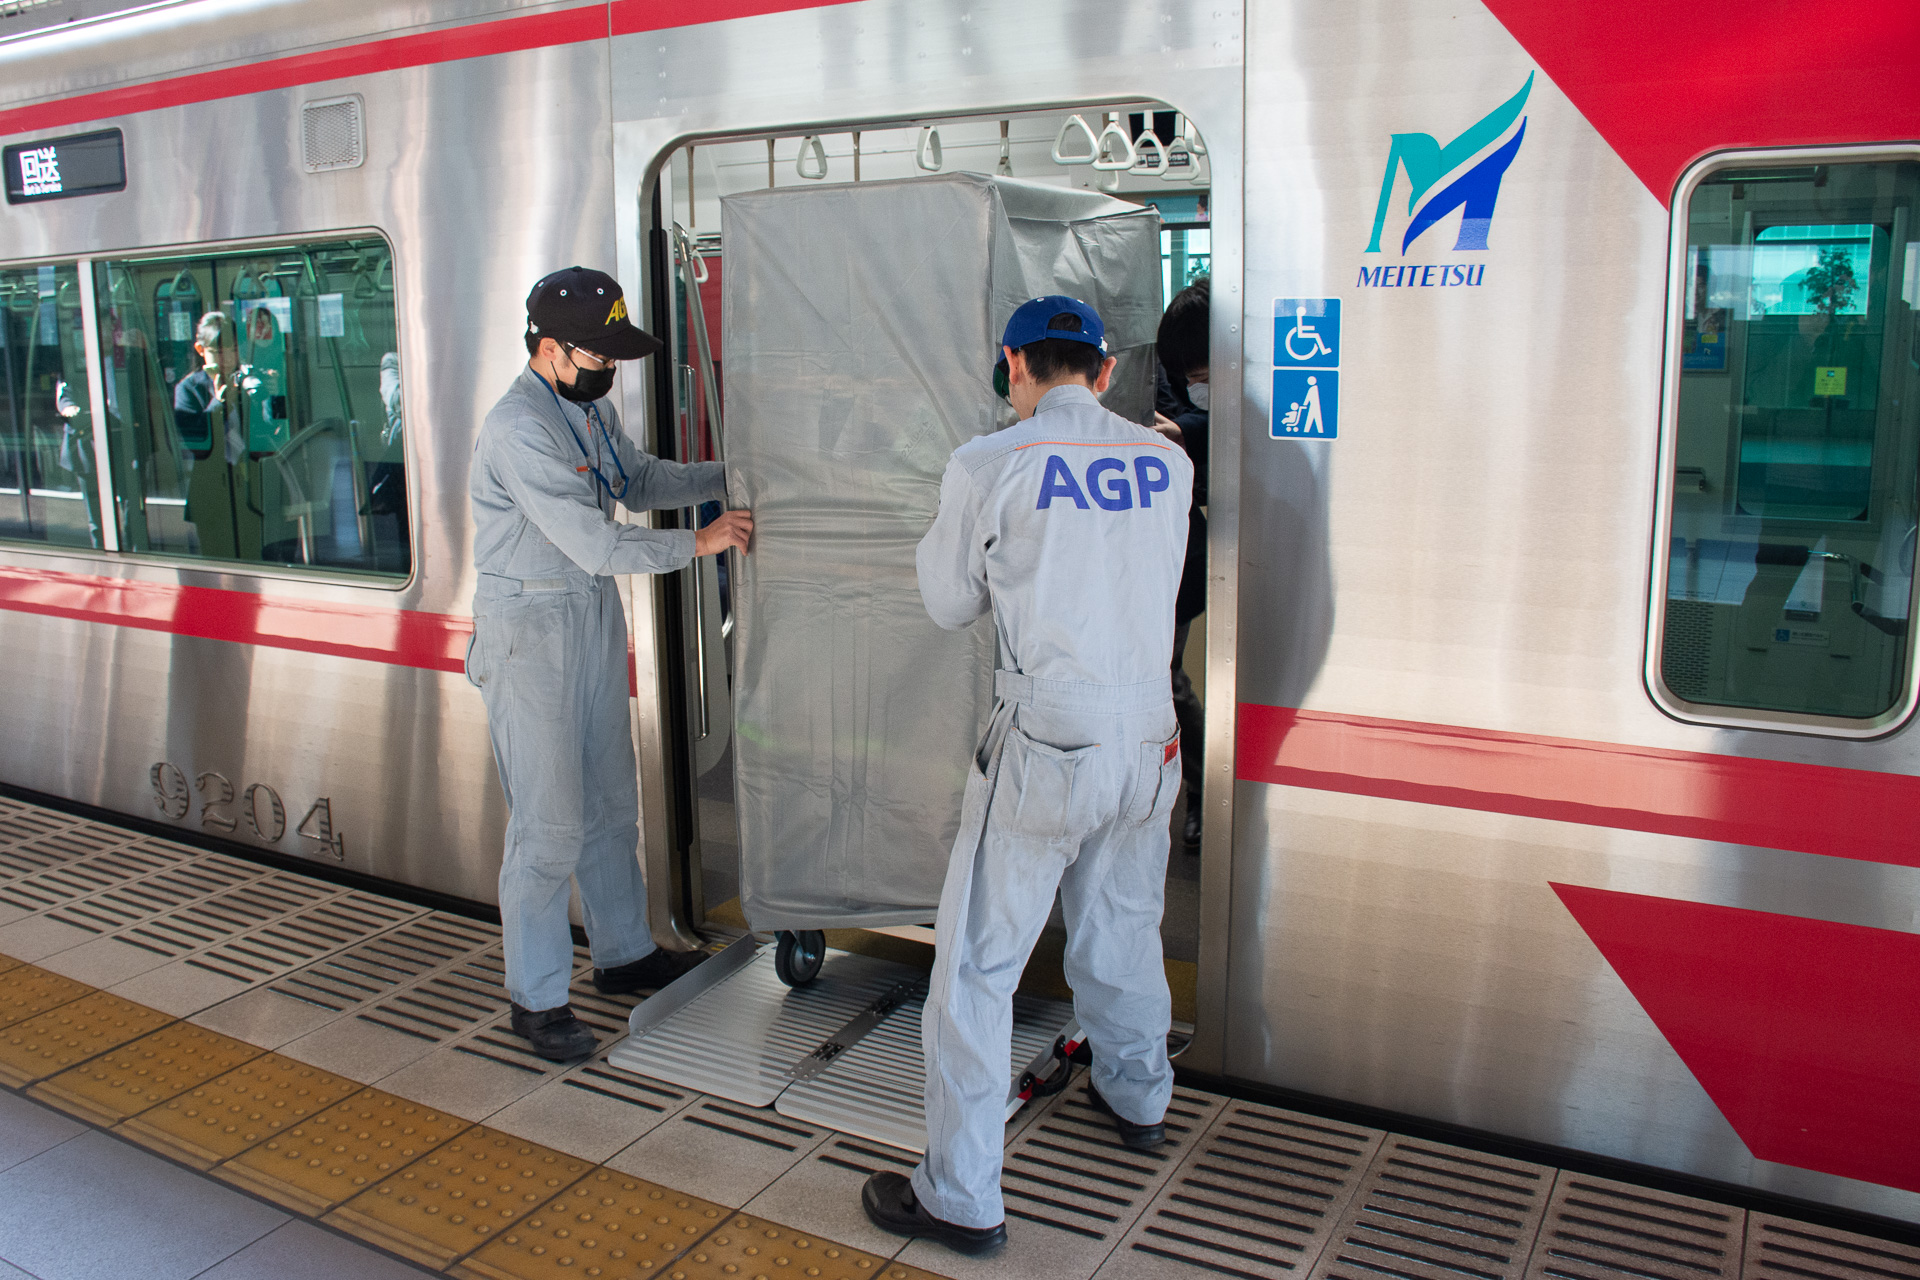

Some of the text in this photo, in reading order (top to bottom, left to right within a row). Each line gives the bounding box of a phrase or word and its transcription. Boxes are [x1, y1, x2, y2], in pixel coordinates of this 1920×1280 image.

[19, 146, 61, 184] 回送
[1356, 265, 1486, 287] MEITETSU
[1036, 455, 1170, 512] AGP
[151, 762, 344, 862] 9204
